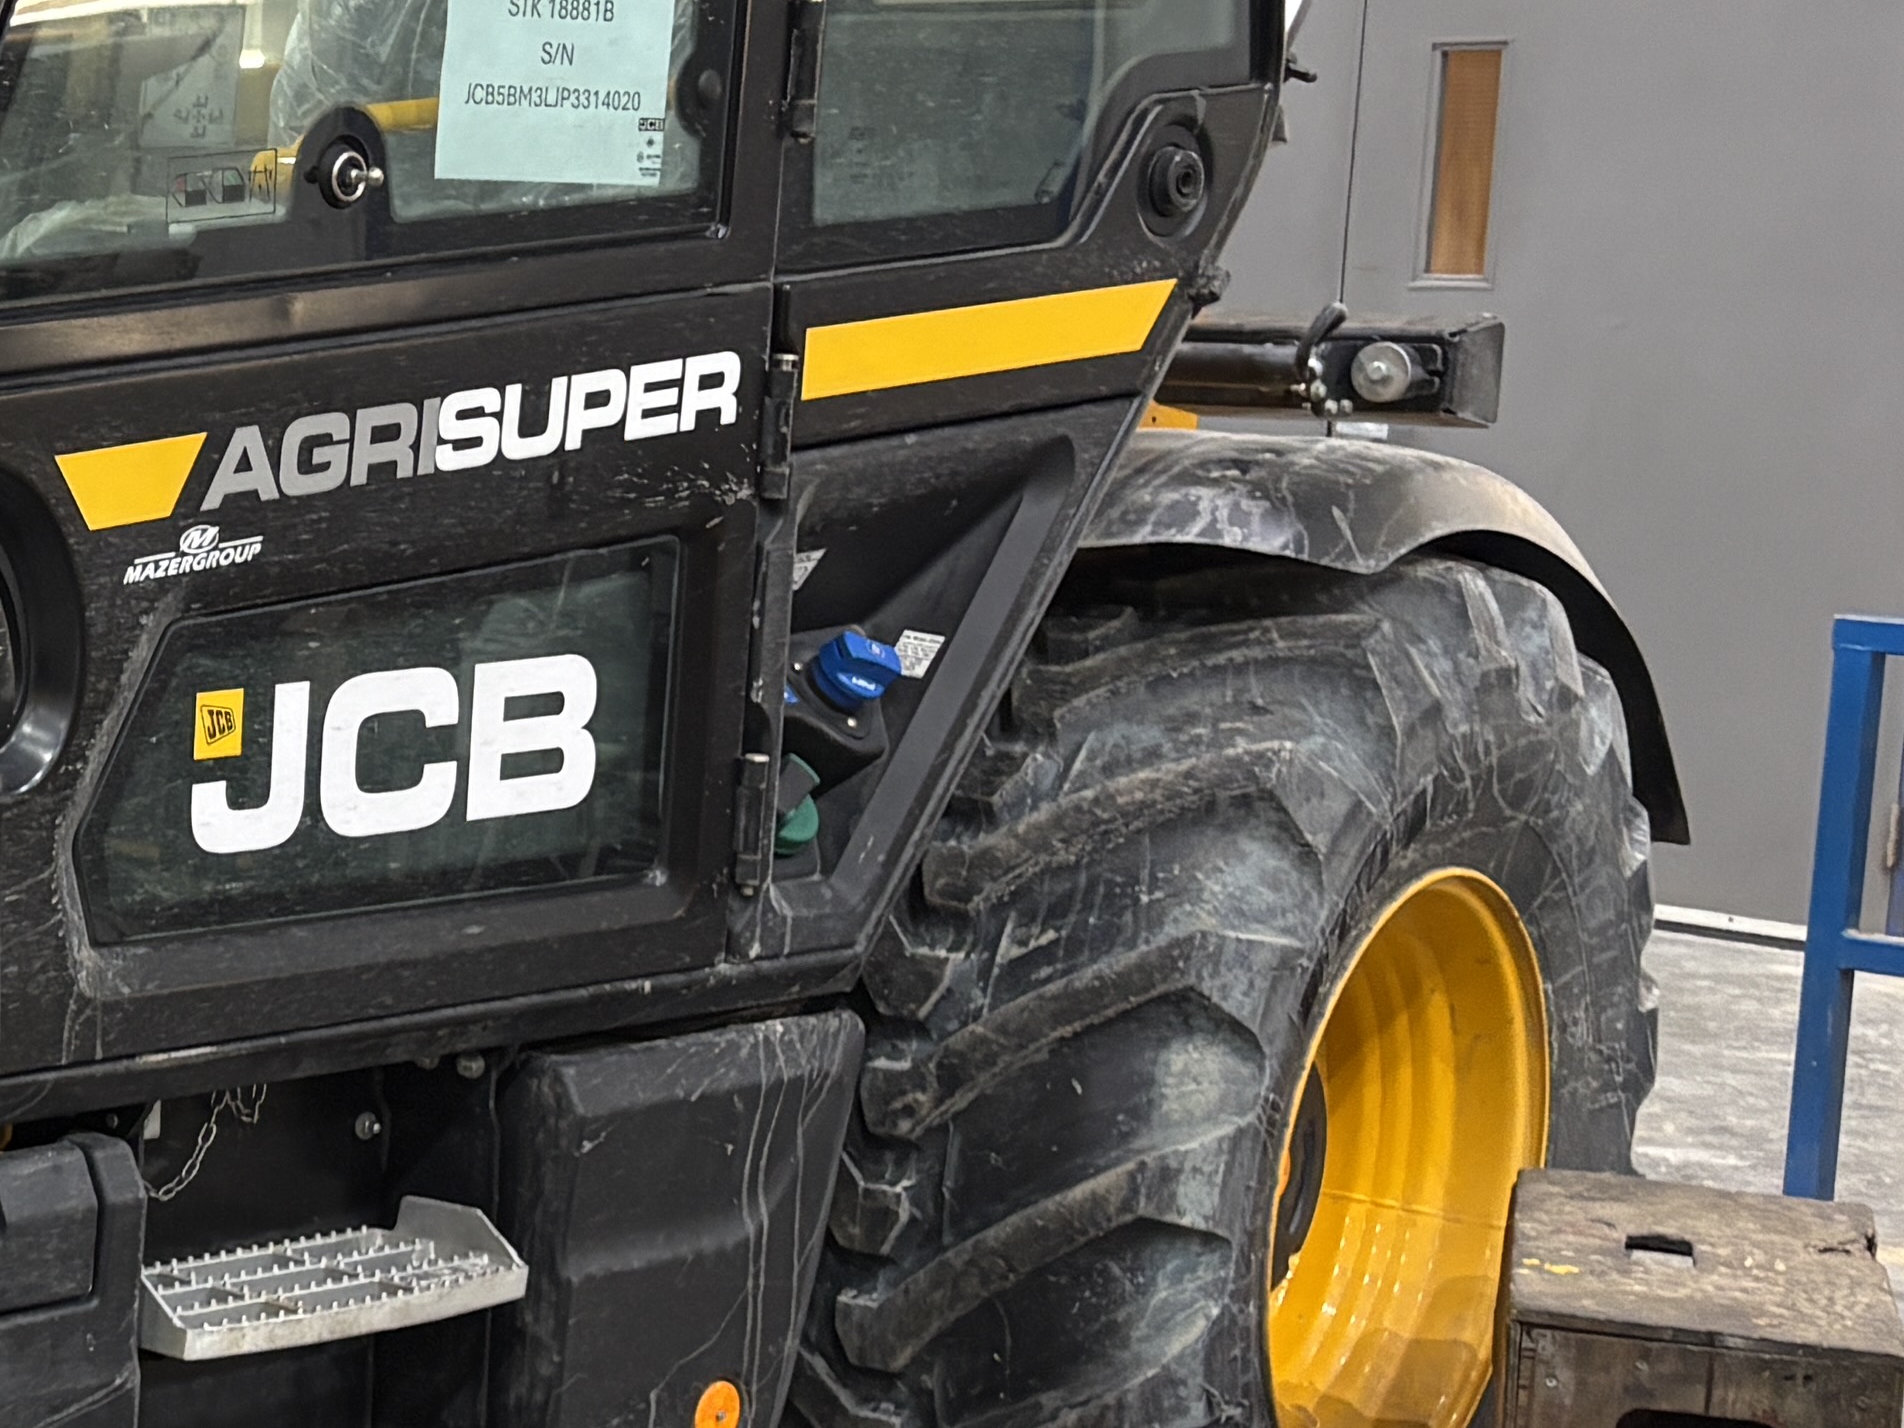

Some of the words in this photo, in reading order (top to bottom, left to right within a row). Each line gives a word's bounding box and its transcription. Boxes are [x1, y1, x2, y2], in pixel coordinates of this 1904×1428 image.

[540, 41, 575, 67] S/N
[464, 82, 642, 112] JCB5BM3LJP3314020
[199, 351, 742, 512] AGRISUPER
[123, 542, 262, 585] MAZERGROUP
[206, 709, 233, 740] JCB
[191, 653, 598, 855] JCB
